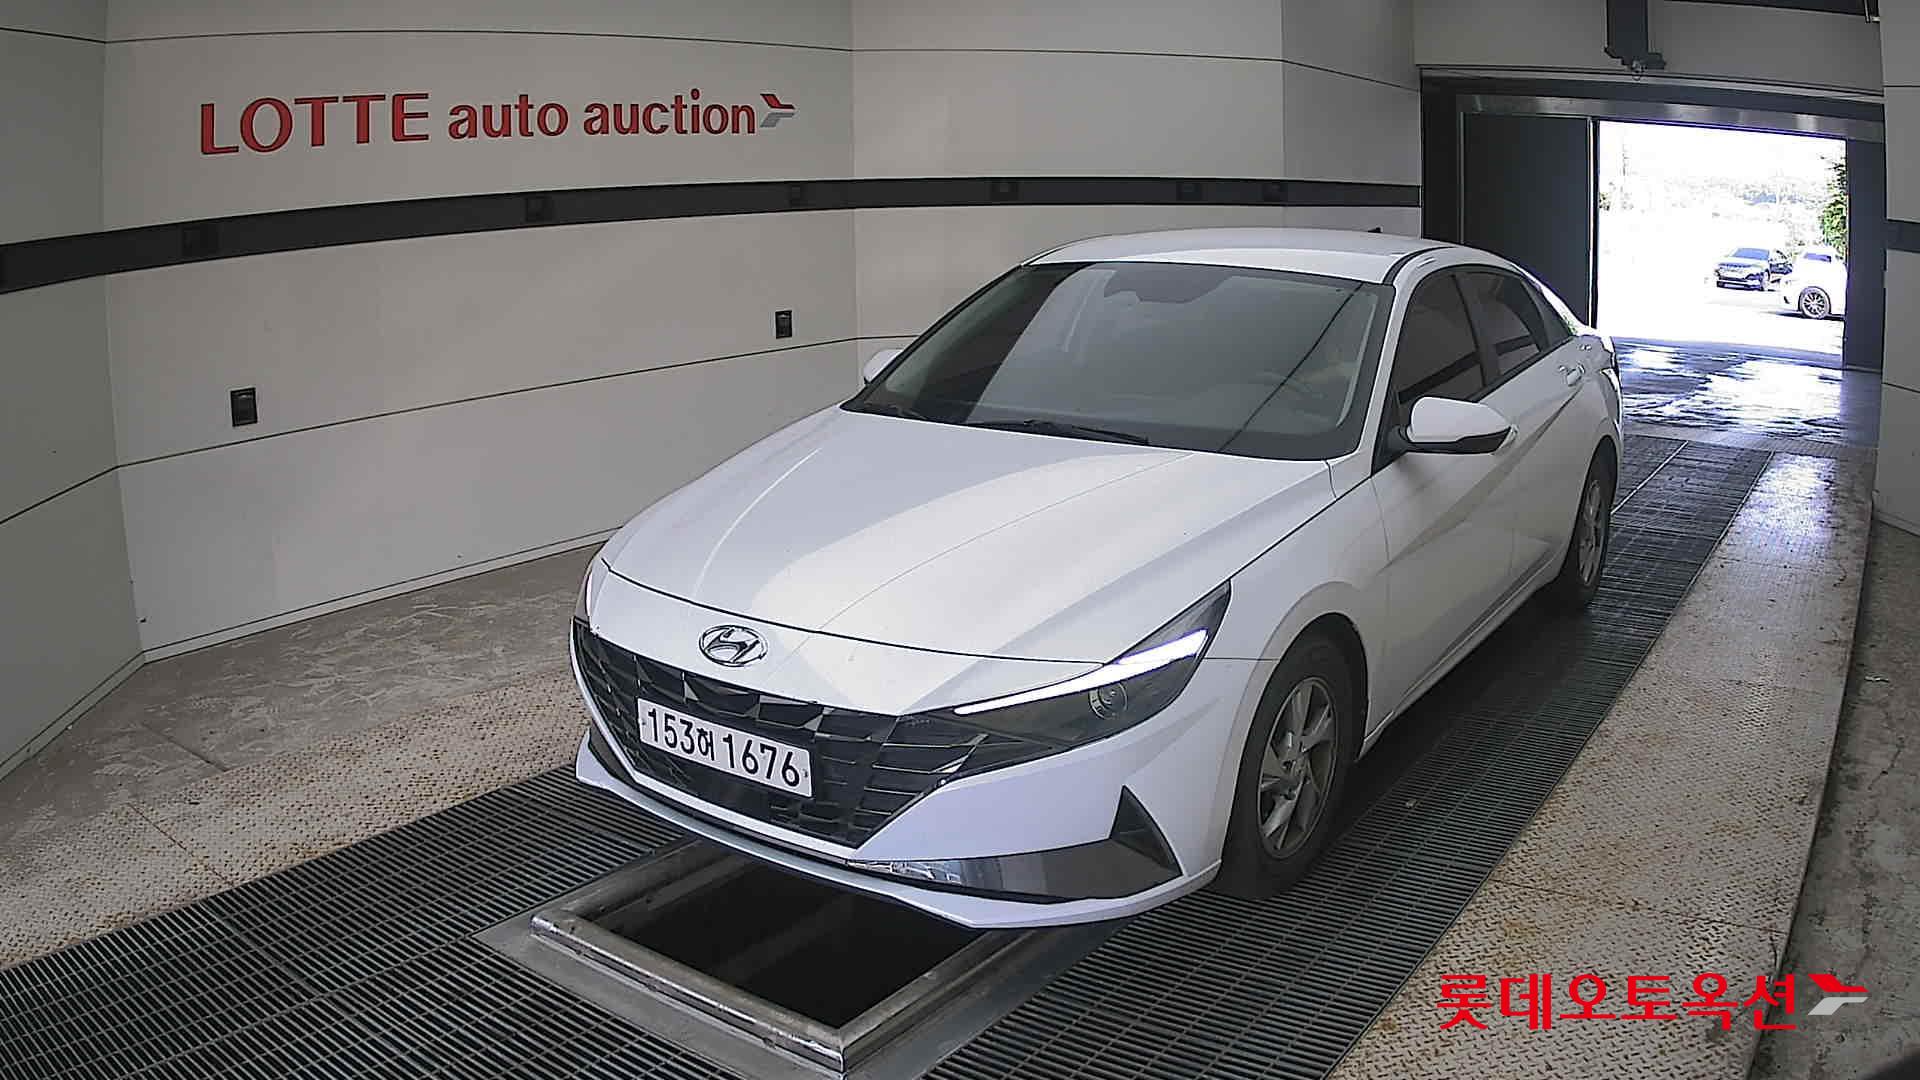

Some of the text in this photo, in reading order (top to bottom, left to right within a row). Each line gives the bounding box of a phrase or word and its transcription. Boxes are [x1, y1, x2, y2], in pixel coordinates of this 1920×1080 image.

[200, 88, 756, 155] LOTTE auto auction
[648, 708, 800, 788] 153허 1676
